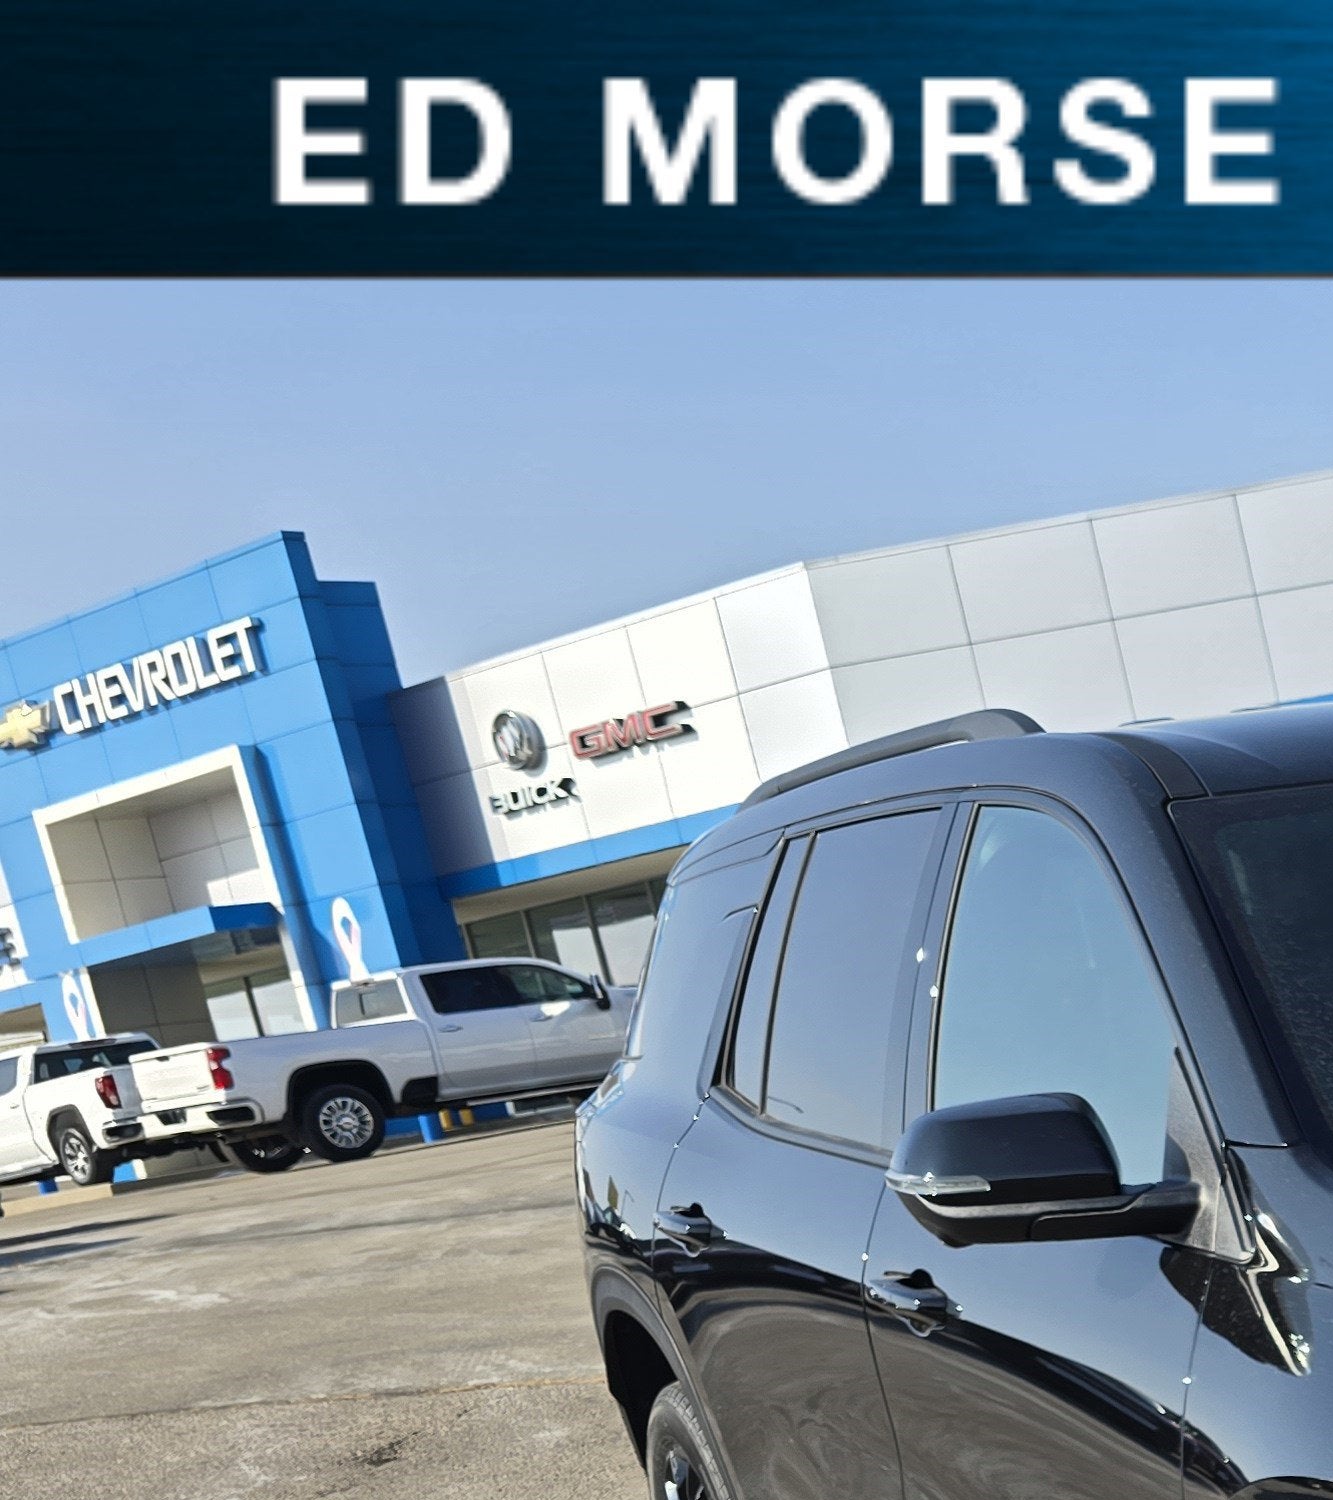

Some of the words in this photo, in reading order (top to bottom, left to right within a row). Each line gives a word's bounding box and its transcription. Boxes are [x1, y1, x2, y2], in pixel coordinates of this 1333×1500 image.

[53, 616, 257, 735] CHEVROLET
[569, 701, 684, 760] GMC
[490, 778, 571, 815] BUICK
